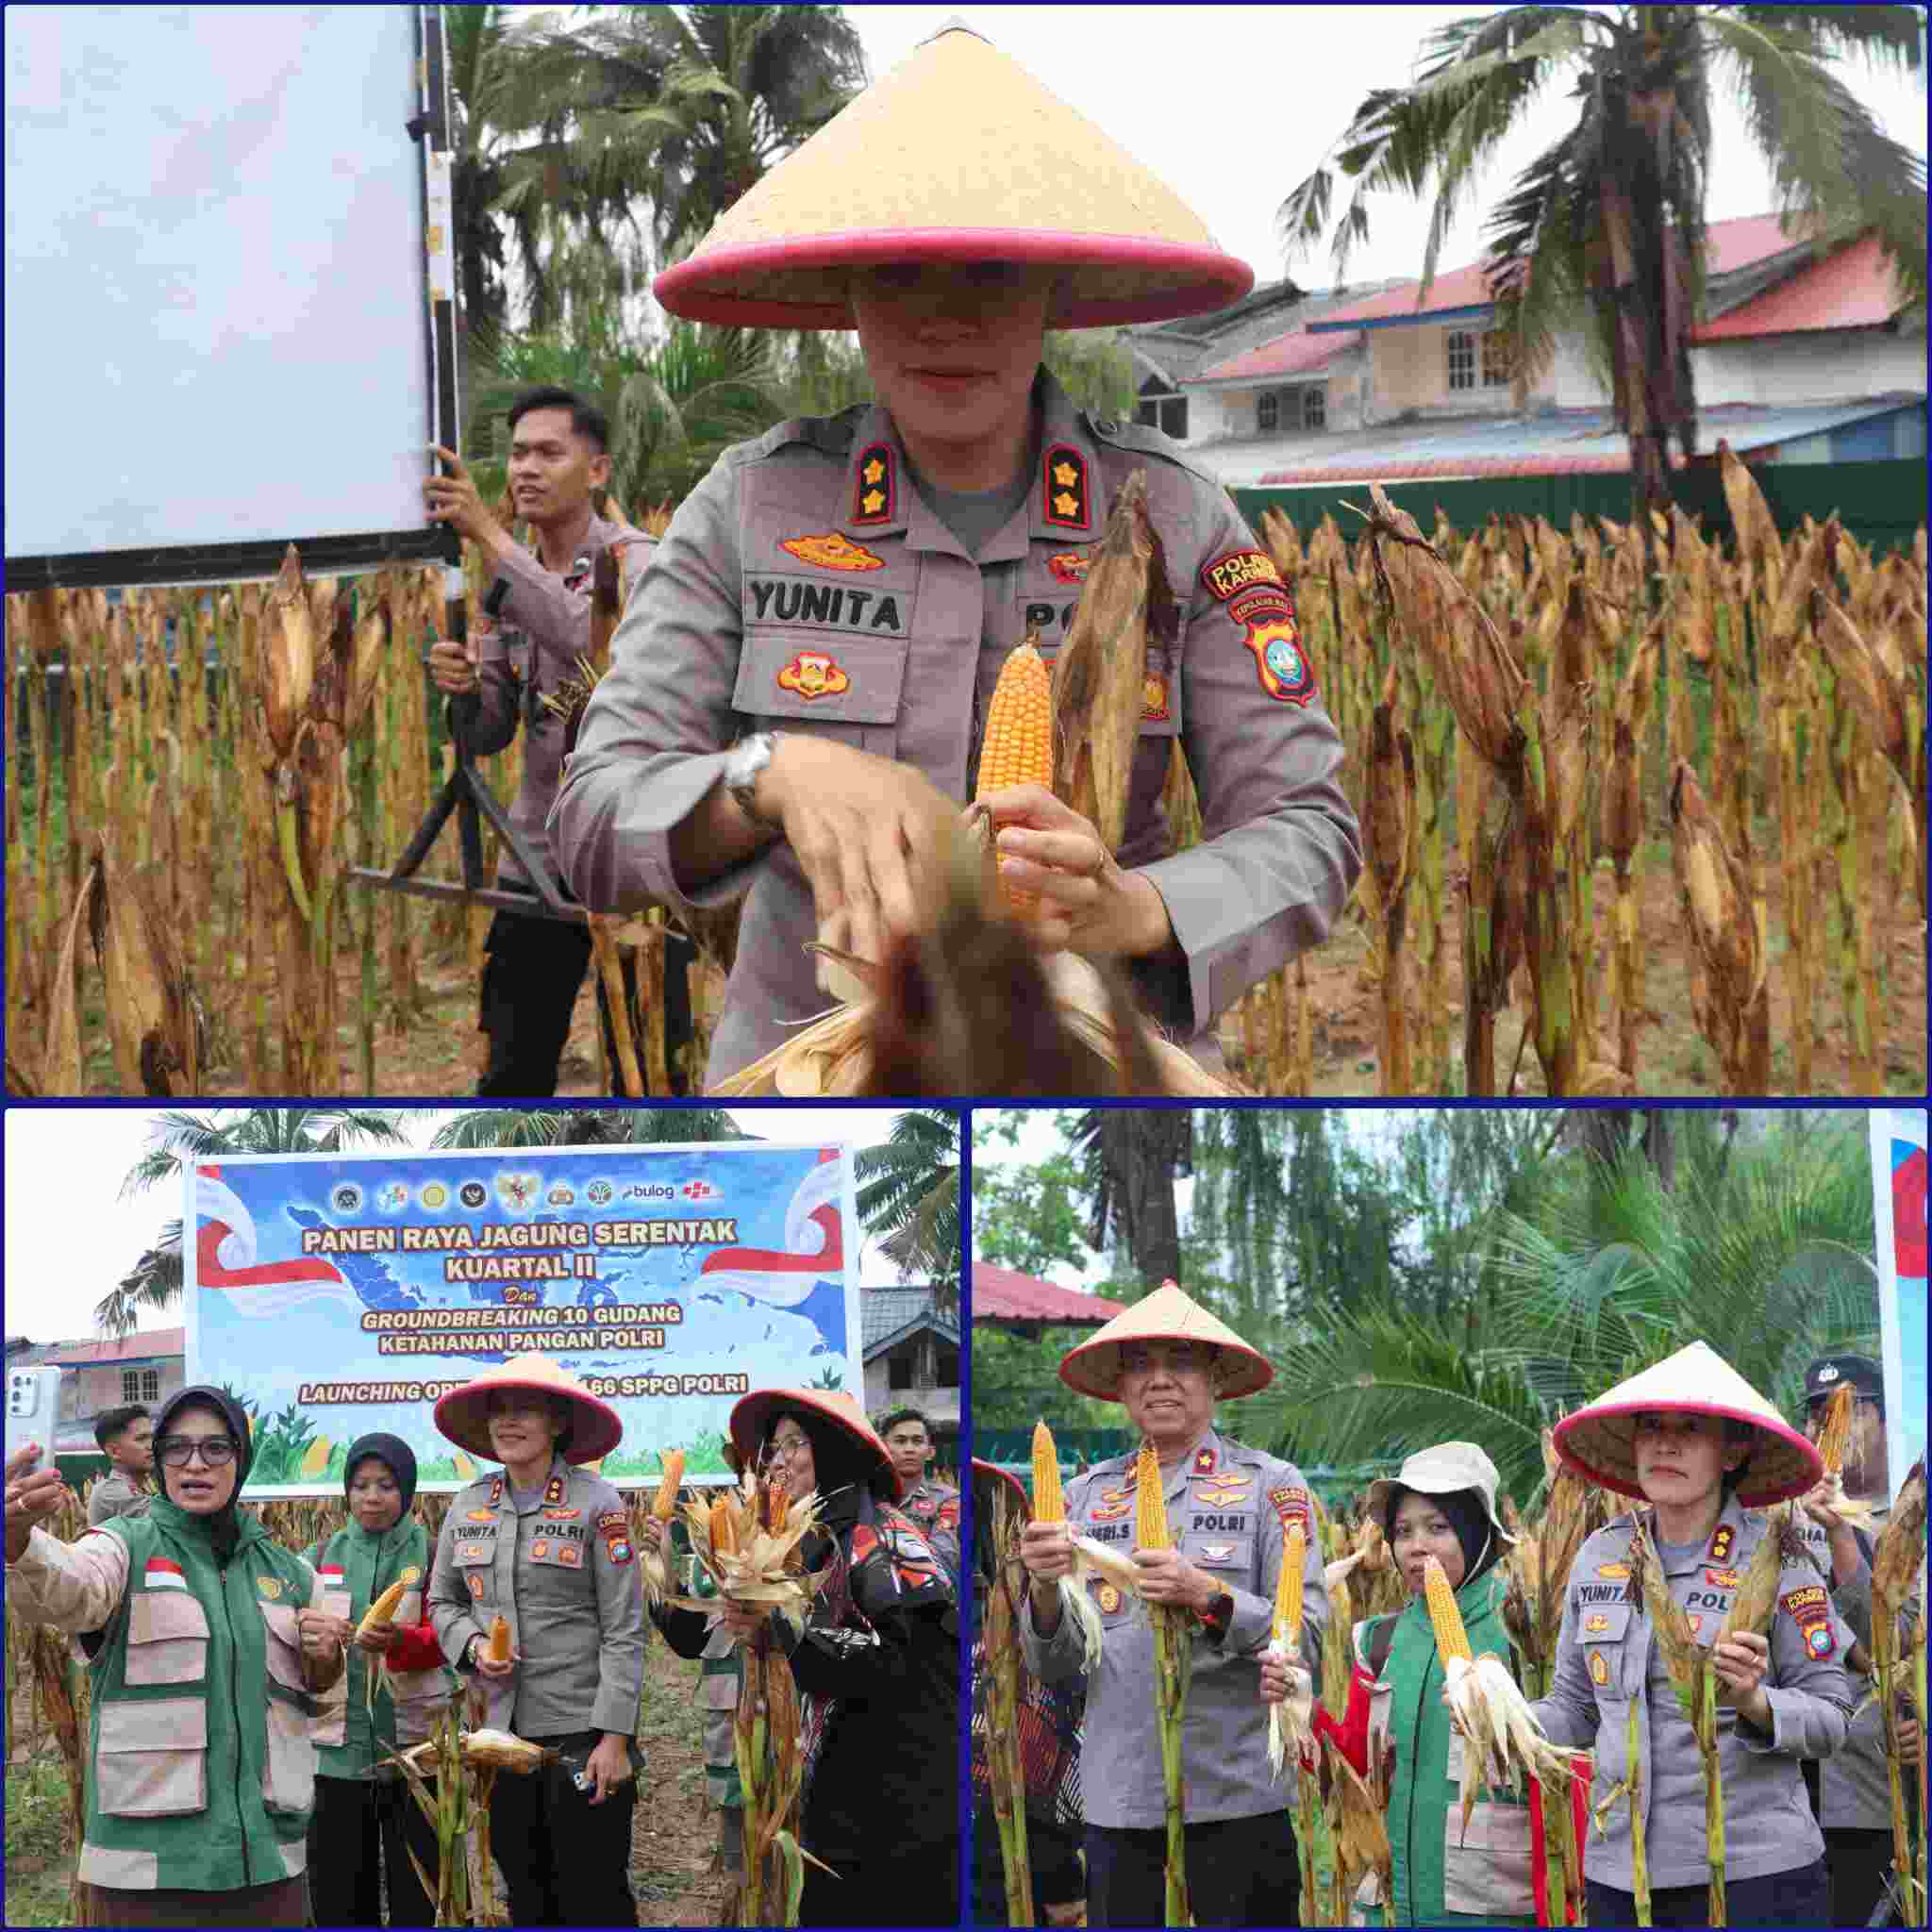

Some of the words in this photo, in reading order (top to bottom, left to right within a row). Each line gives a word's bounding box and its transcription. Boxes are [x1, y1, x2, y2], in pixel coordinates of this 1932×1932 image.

[751, 580, 901, 630] YUNITA
[633, 1184, 675, 1199] bulog
[304, 1229, 395, 1252] PANEN
[403, 1226, 474, 1250] RAYA
[480, 1224, 589, 1248] JAGUNG
[593, 1220, 737, 1244] SERENTAK
[446, 1254, 570, 1280] KUARTAL
[575, 1255, 593, 1276] II
[505, 1287, 536, 1303] Dan
[363, 1307, 558, 1329] GROUNDBREAKING
[563, 1307, 589, 1324] 10
[593, 1305, 681, 1324] GUDANG
[380, 1334, 503, 1353] KETAHANAN
[509, 1331, 594, 1350] PANGAN
[600, 1328, 665, 1348] POLRI
[300, 1382, 423, 1404] LAUNCHING
[621, 1376, 679, 1396] SPPG
[683, 1374, 748, 1393] POLRI
[535, 1524, 585, 1540] POLRI
[1192, 1514, 1245, 1531] POLRI
